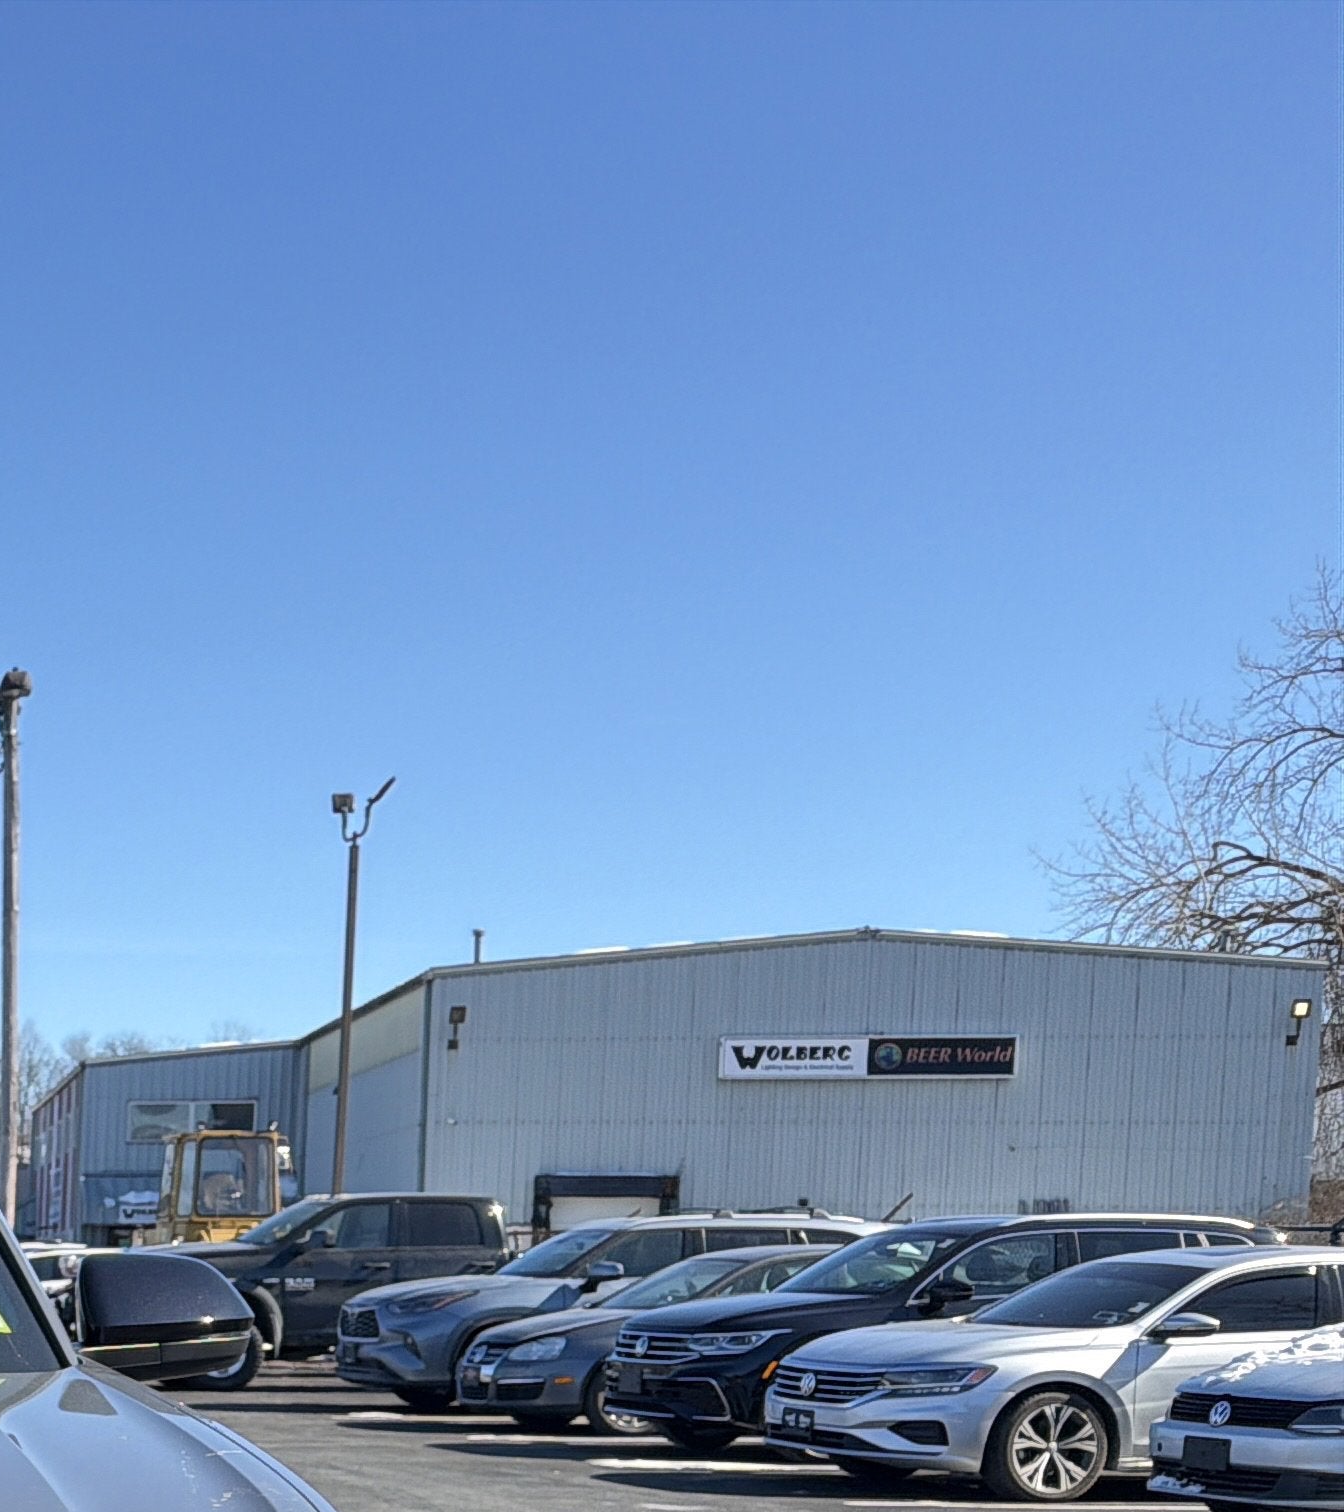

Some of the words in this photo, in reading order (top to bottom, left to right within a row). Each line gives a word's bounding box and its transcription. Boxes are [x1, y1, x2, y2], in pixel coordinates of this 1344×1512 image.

[730, 1045, 853, 1070] WOLBERG
[906, 1047, 952, 1063] BEER
[957, 1045, 1012, 1063] World
